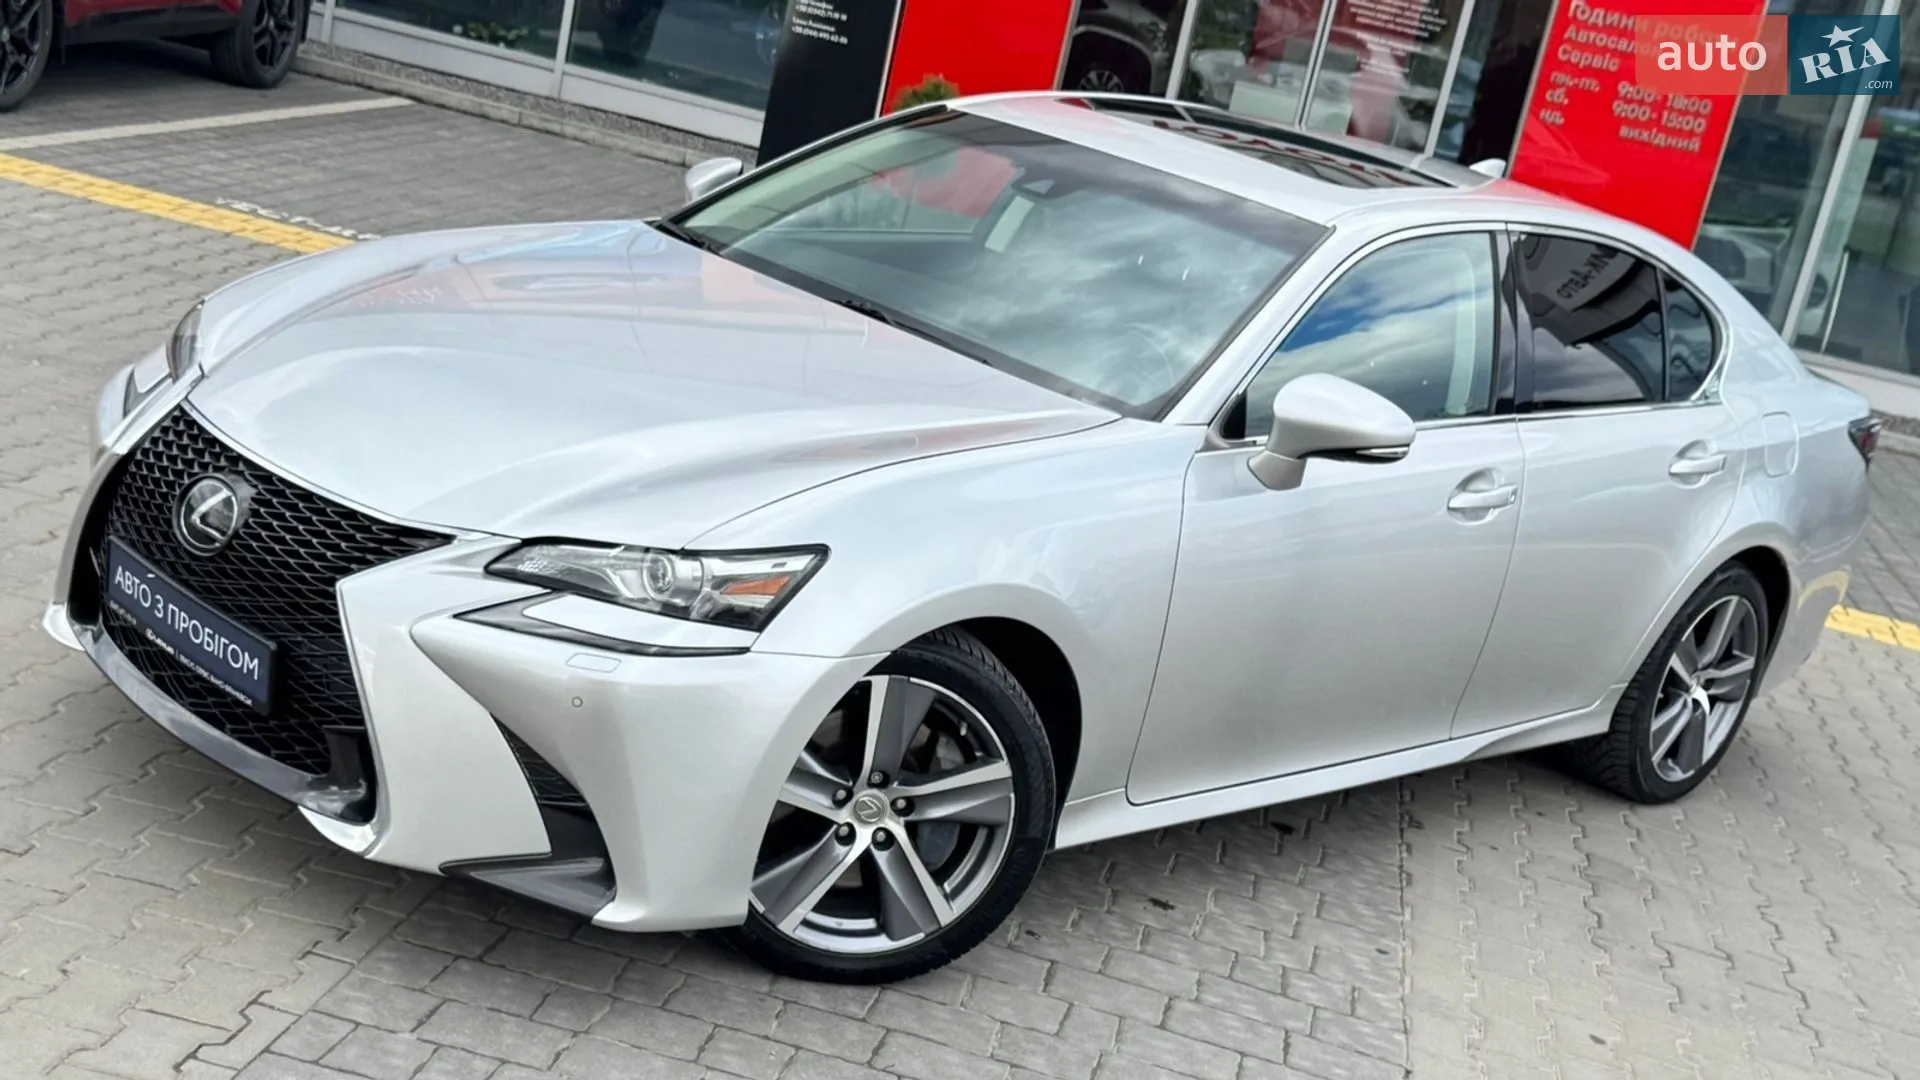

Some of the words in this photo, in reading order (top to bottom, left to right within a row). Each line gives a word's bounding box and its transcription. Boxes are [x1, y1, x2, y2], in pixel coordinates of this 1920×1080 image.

[1568, 1, 1649, 34] Години
[1557, 44, 1621, 72] Сервіс
[1666, 92, 1713, 116] 18:00
[1661, 109, 1707, 134] 15:00
[114, 565, 152, 608] АВТО
[154, 594, 165, 619] З
[167, 603, 260, 681] ПРОБІГОМ
